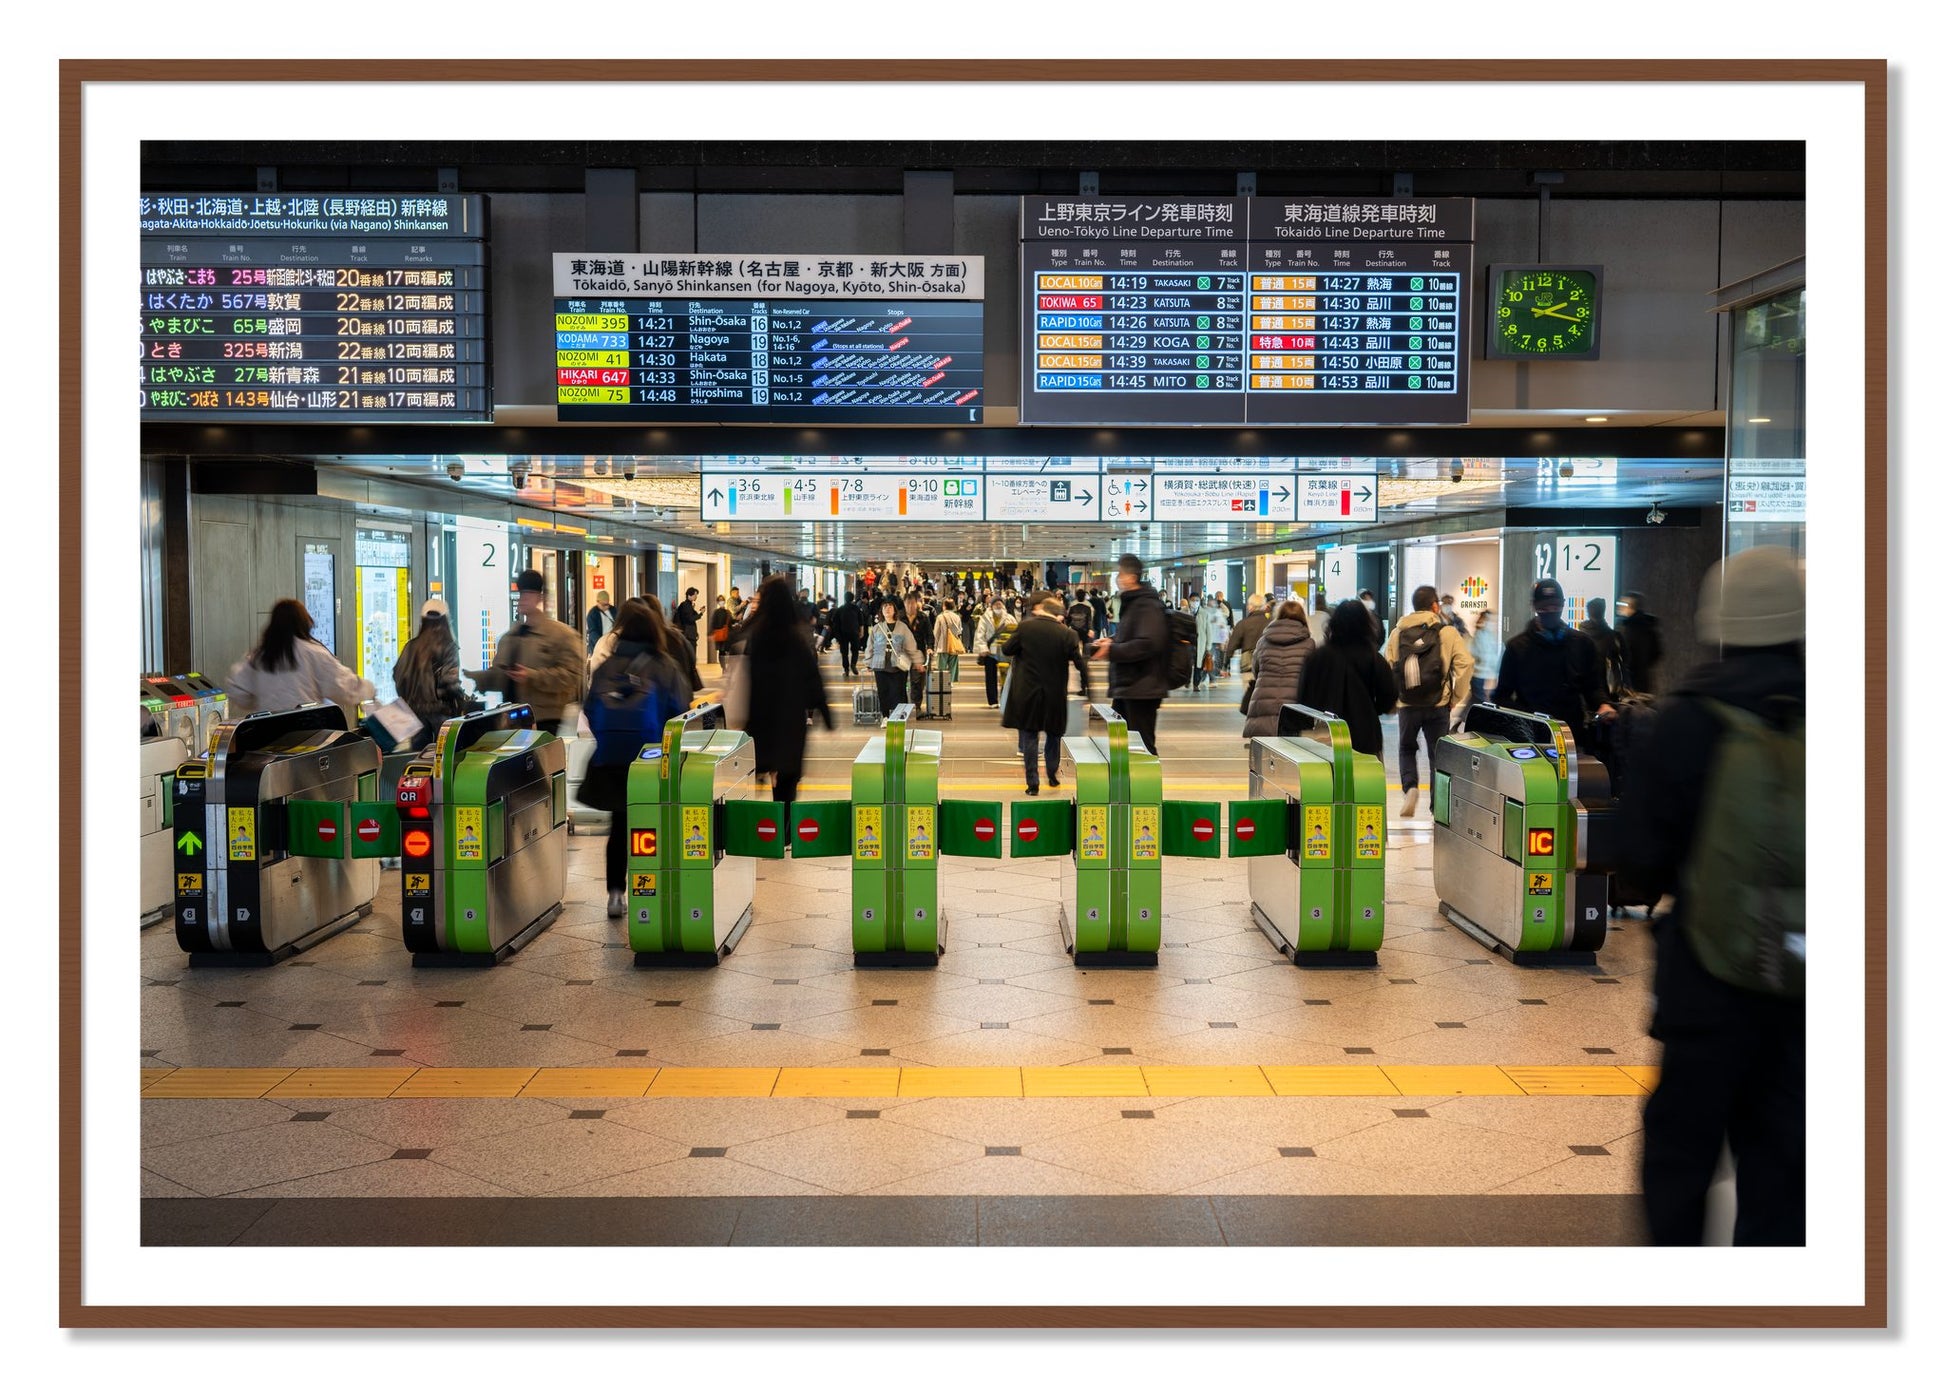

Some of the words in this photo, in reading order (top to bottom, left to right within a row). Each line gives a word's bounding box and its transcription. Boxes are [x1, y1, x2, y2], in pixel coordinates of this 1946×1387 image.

[1038, 203, 1233, 223] 上野東京ライン発車時刻
[1284, 204, 1436, 223] 東海道線発車時刻
[331, 219, 347, 231] (via
[350, 220, 391, 232] Nagano)
[394, 219, 448, 230] Shinkansen
[1038, 225, 1109, 239] Ueno-Tōkyō
[1113, 226, 1137, 237] Line
[1141, 226, 1201, 239] Departure
[1205, 226, 1234, 237] Time
[1275, 226, 1322, 237] Tōkaidō
[1325, 227, 1350, 237] Line
[1353, 227, 1413, 240] Departure
[1417, 227, 1446, 238] Time
[1051, 259, 1067, 267] Type
[232, 269, 267, 285] 25号
[386, 270, 453, 286] 17両編成
[1040, 277, 1077, 288] LOCAL
[1110, 277, 1147, 289] 14:19
[1154, 279, 1191, 287] TAKASAKI
[1260, 278, 1284, 290] 普通
[1323, 277, 1360, 290] 14:27
[1367, 277, 1392, 291] 熱海
[1537, 276, 1552, 287] 12
[573, 279, 630, 293] Tōkaidō,
[634, 279, 674, 294] Sanyō
[677, 279, 752, 292] Shinkansen
[757, 280, 780, 294] (for
[785, 281, 839, 295] Nagoya,
[842, 281, 885, 295] Kyōto,
[889, 280, 966, 294] Shin-Ōsaka)
[1523, 281, 1535, 291] 11
[149, 293, 214, 309] はくたか
[222, 293, 267, 309] 567号
[267, 293, 301, 311] 敦賀
[386, 295, 453, 311] 12両編成
[1041, 298, 1077, 307] TOKIWA
[1110, 297, 1147, 309] 14:23
[1153, 298, 1190, 308] KATSUTA
[1509, 291, 1523, 302] 10
[1322, 297, 1360, 310] 14:30
[1366, 297, 1392, 311] 品川
[887, 309, 904, 317] Stops
[1501, 307, 1511, 318] 9
[1576, 307, 1586, 318] 3
[149, 317, 215, 334] やまびこ
[233, 318, 267, 334] 65号
[268, 317, 301, 335] 盛岡
[387, 319, 454, 335] 10両編成
[557, 316, 598, 325] NOZOMI
[601, 317, 626, 329] 395
[638, 318, 673, 330] 14:21
[689, 315, 746, 326] Shin-Ōsaka
[752, 318, 766, 330] 16
[1040, 317, 1077, 327] RAPID
[1110, 316, 1147, 329] 14:26
[1153, 318, 1190, 327] KATSUTA
[1322, 317, 1359, 330] 14:37
[1366, 317, 1391, 331] 熱海
[558, 334, 598, 343] KODAMA
[601, 335, 626, 347] 733
[638, 335, 675, 348] 14:27
[689, 334, 730, 346] Nagoya
[753, 336, 766, 348] 19
[1040, 337, 1077, 347] LOCAL
[1110, 336, 1146, 348] 14:29
[1153, 337, 1190, 347] KOGA
[1259, 337, 1283, 349] 特急
[1322, 336, 1359, 349] 14:43
[1366, 337, 1390, 350] 品川
[1537, 338, 1547, 349] 6
[151, 341, 183, 358] とき
[223, 343, 268, 358] 325号
[268, 342, 303, 360] 新潟
[387, 343, 454, 359] 12両編成
[558, 352, 599, 361] NOZOMI
[605, 354, 622, 365] 41
[638, 354, 675, 366] 14:30
[689, 352, 727, 362] Hakata
[753, 354, 766, 366] 18
[1040, 357, 1077, 367] LOCAL
[1109, 356, 1146, 368] 14:39
[1153, 358, 1190, 366] TAKASAKI
[1259, 357, 1283, 369] 普通
[1321, 356, 1359, 369] 14:50
[1365, 356, 1402, 369] 小田原
[151, 366, 216, 383] はやぶさ
[234, 367, 268, 383] 27号
[268, 366, 320, 384] 新青森
[388, 368, 455, 383] 10両編成
[560, 370, 598, 379] HIKARI
[602, 371, 627, 383] 647
[639, 372, 675, 384] 14:33
[690, 369, 747, 380] Shin-Ōsaka
[753, 372, 766, 384] 15
[773, 374, 803, 383] No.1-5
[1040, 376, 1077, 387] RAPID
[1109, 375, 1146, 388] 14:45
[1153, 376, 1186, 387] MITO
[1321, 376, 1358, 389] 14:53
[1365, 376, 1389, 389] 品川
[226, 391, 269, 407] 143号
[270, 390, 337, 408] 仙台・山形
[388, 392, 455, 408] 17両編成
[559, 387, 600, 397] NOZOMI
[606, 389, 623, 401] 75
[639, 390, 676, 402] 14:48
[690, 387, 743, 399] Hiroshima
[753, 390, 766, 402] 19
[1307, 480, 1338, 490] 京葉線
[739, 493, 775, 501] 京浜東北線
[793, 493, 815, 501] 山手線
[841, 493, 889, 501] 上野東京ライン
[944, 499, 974, 509] 新幹線
[482, 543, 496, 567] 2
[1331, 560, 1341, 576] 4
[1460, 600, 1488, 609] GRANSTA
[400, 791, 417, 802] QR
[633, 832, 656, 854] IC
[1530, 832, 1553, 854] IC
